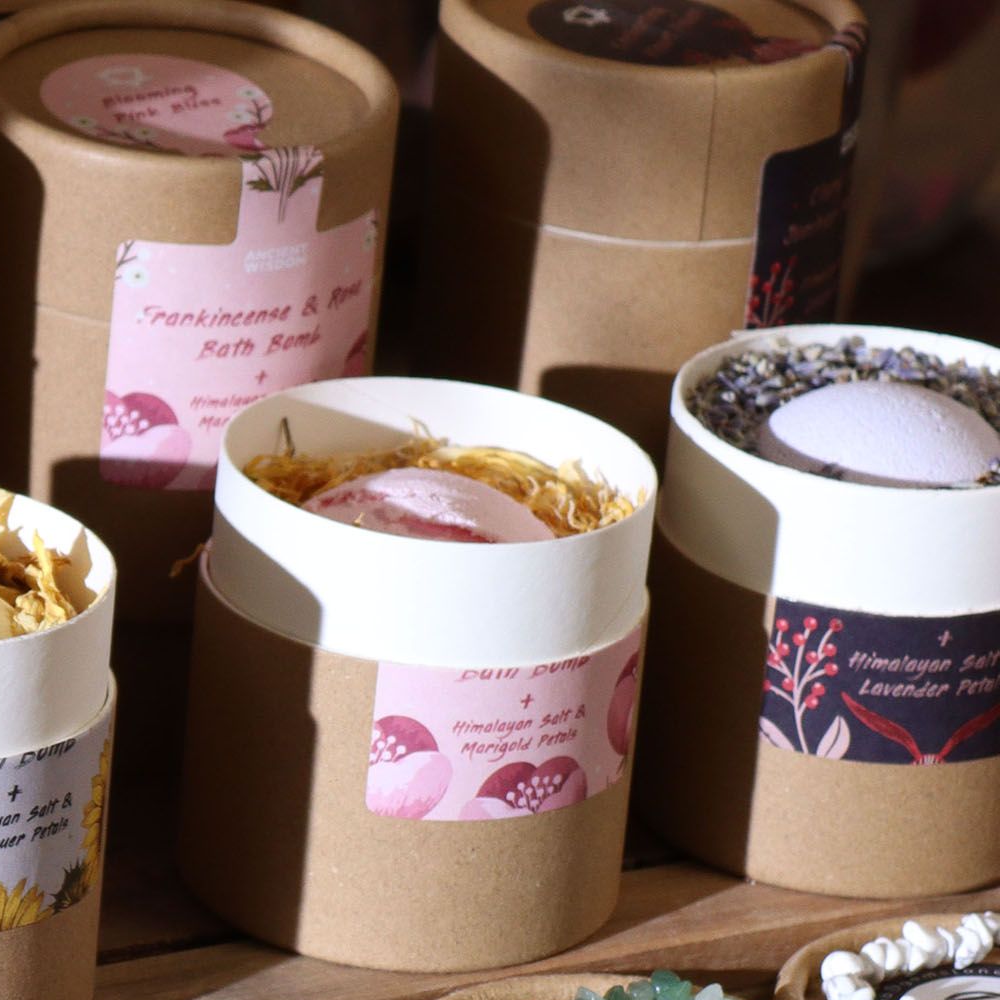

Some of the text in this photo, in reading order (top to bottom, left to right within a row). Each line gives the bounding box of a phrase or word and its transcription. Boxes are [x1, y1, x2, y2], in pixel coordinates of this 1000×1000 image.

[302, 295, 320, 318] &
[195, 324, 322, 361] Bath Bomb
[848, 650, 952, 680] Himalayan
[858, 677, 950, 699] Lavender
[452, 703, 587, 739] Himalayan Salt &
[460, 729, 579, 763] Marigold Petals
[26, 797, 60, 822] Salt
[61, 792, 73, 808] &
[31, 817, 70, 842] Petals
